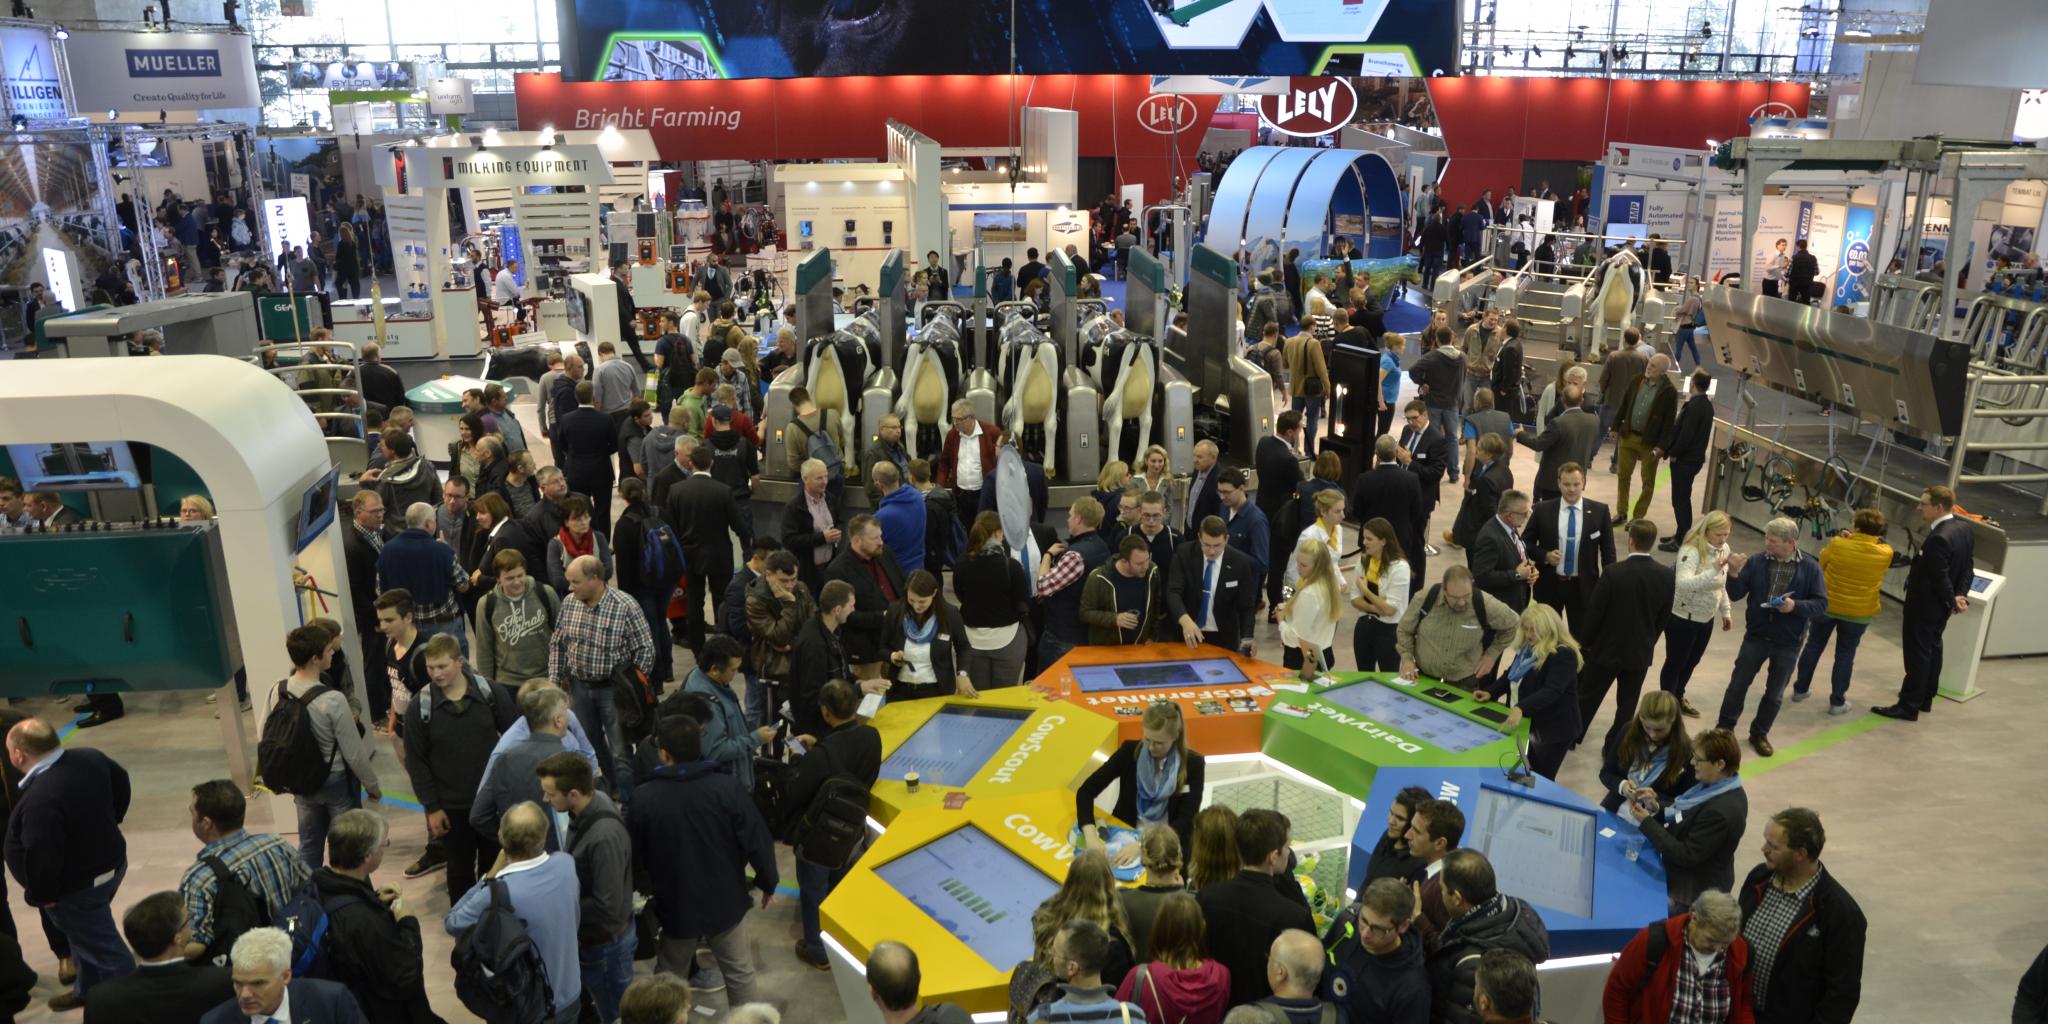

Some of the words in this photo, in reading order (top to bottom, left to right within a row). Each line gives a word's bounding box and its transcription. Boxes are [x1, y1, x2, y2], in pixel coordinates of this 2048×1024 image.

[133, 55, 216, 71] MUELLER
[331, 79, 371, 87] SYLCO
[133, 93, 167, 102] Create
[167, 92, 200, 102] Quality
[200, 92, 212, 100] for
[212, 91, 226, 100] Life
[1277, 81, 1338, 125] LELY
[575, 106, 645, 128] Bright
[650, 106, 741, 130] Farming
[1150, 101, 1185, 126] LELY
[458, 161, 512, 175] MILKING
[516, 159, 588, 173] EQUIPMENT
[1648, 205, 1664, 213] Fully
[1086, 685, 1264, 706] 65FarmNet
[1307, 702, 1423, 754] DairyNet
[989, 714, 1066, 784] CowScout
[1003, 813, 1075, 866] CowV
